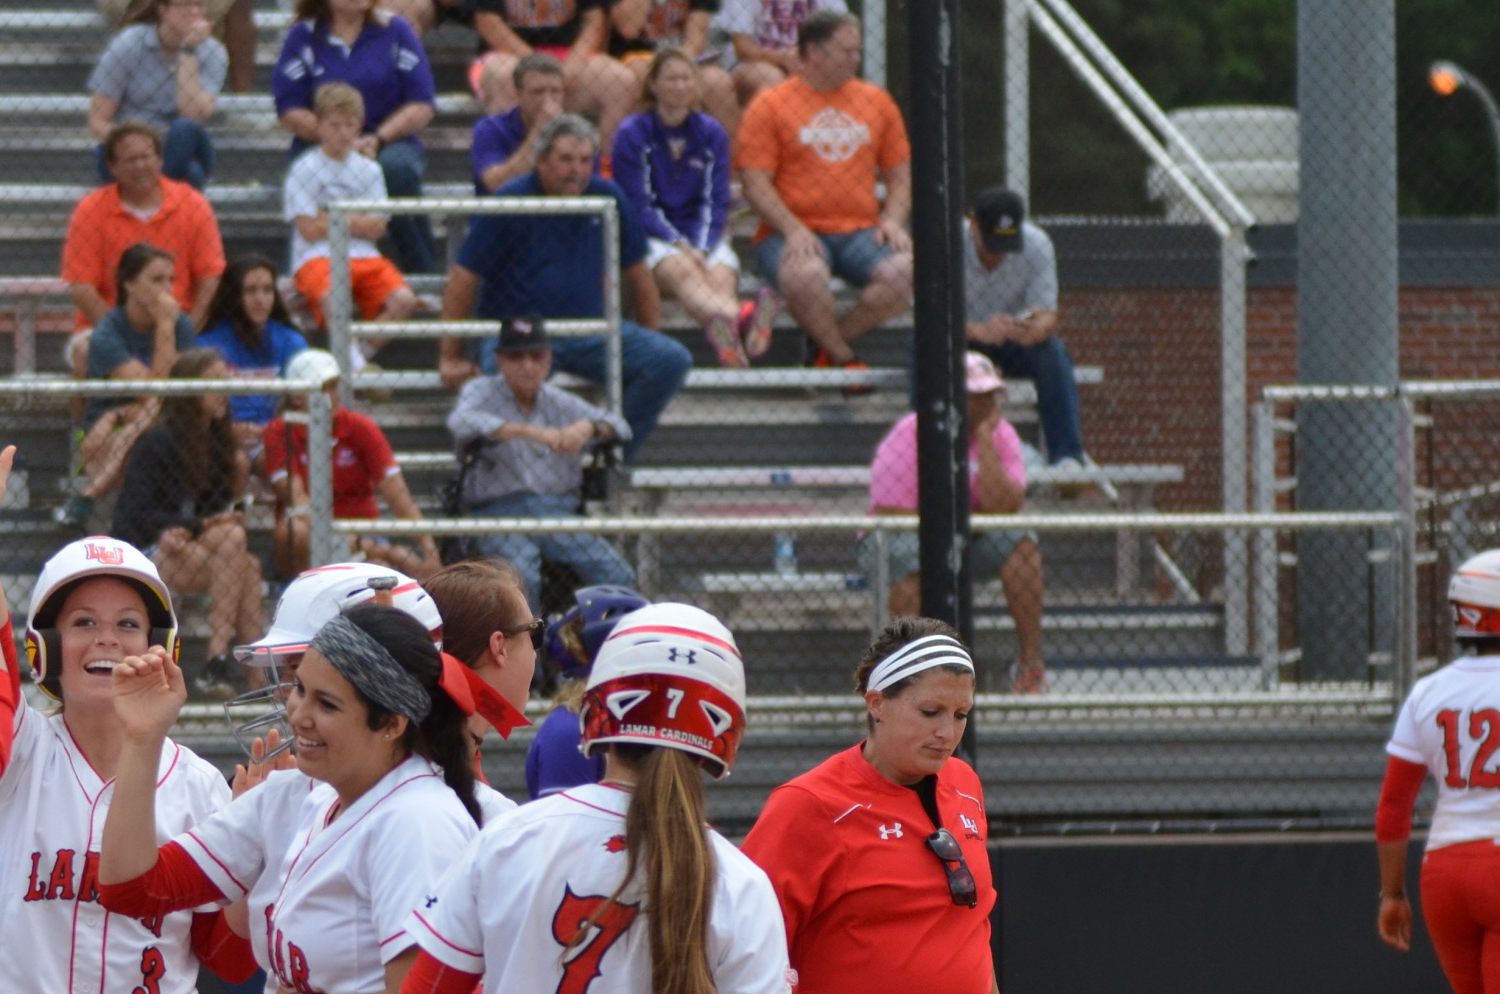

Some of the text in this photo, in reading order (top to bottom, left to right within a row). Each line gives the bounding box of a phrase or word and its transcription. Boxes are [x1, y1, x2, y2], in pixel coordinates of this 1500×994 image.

[665, 687, 686, 720] 7
[619, 723, 715, 751] LAMAR CARDINALS
[1436, 707, 1500, 790] 12
